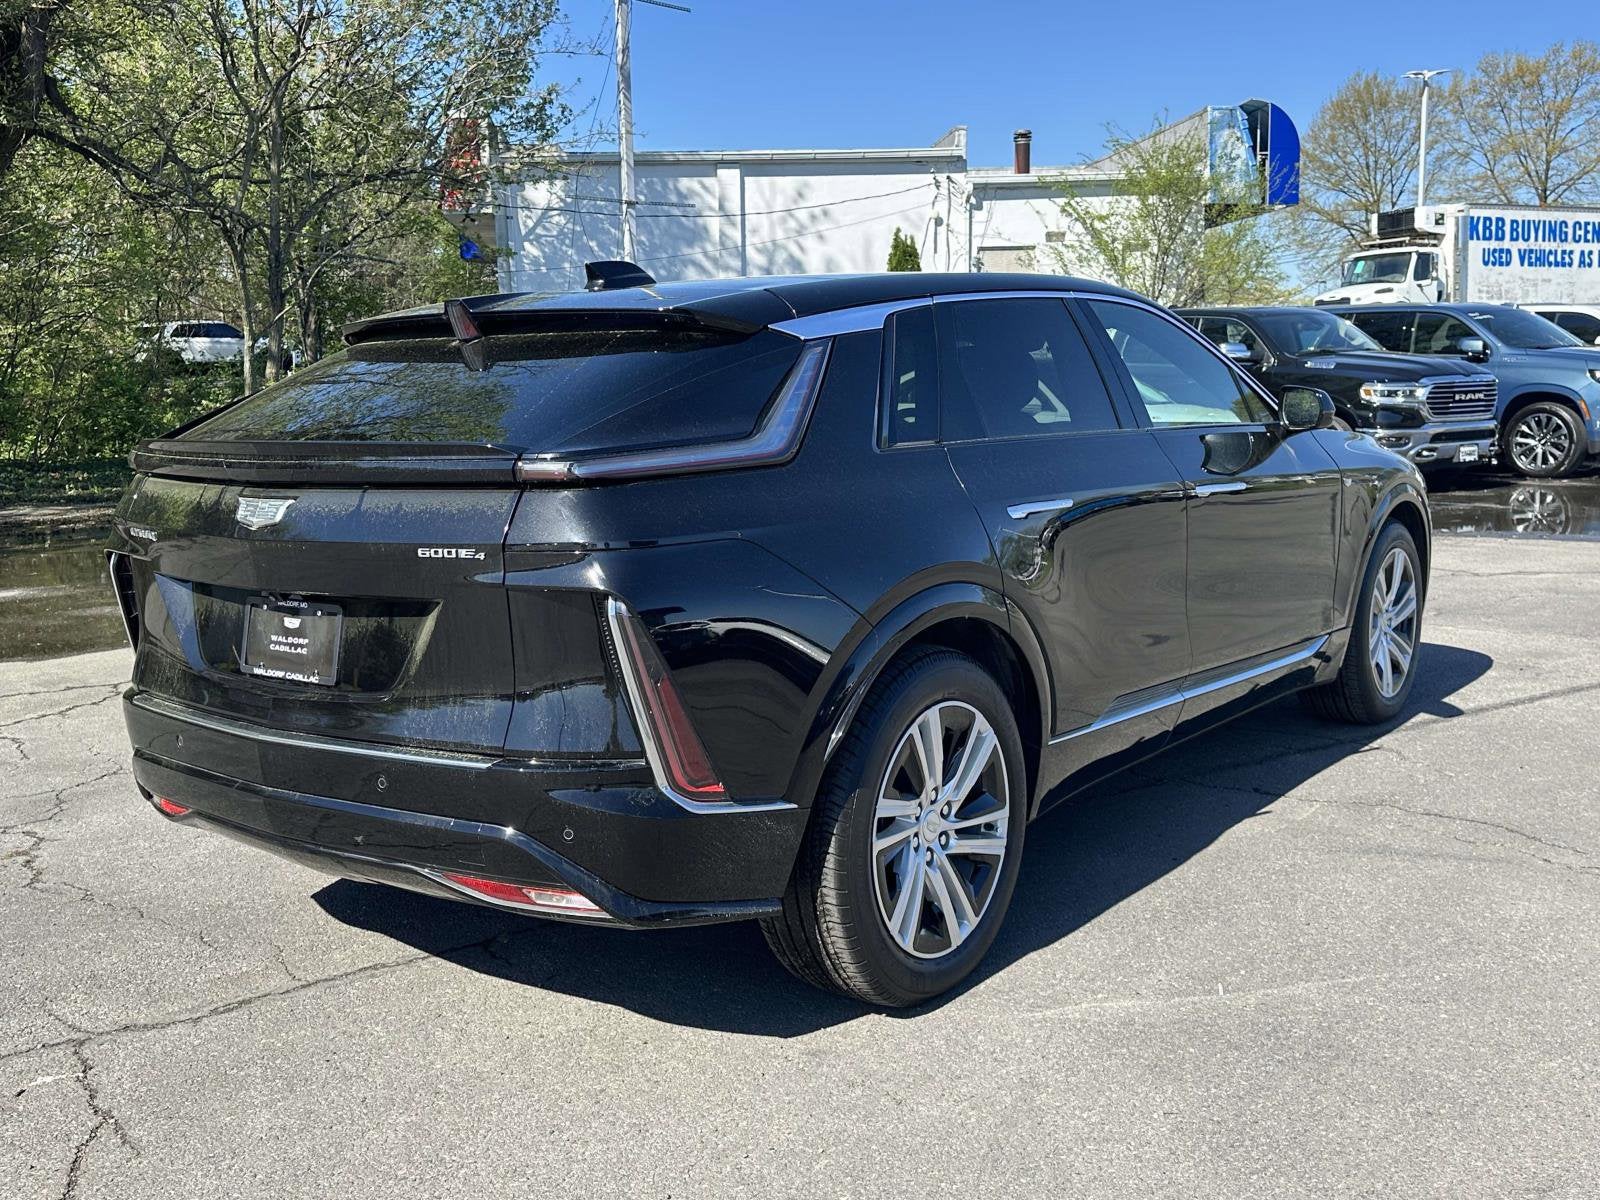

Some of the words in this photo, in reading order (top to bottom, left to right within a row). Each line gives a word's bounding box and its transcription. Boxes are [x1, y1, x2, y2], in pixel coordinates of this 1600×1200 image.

[1469, 216, 1506, 241] KBB
[1509, 219, 1569, 243] BUYING
[1482, 248, 1512, 267] USED
[1517, 248, 1574, 268] VEHICLES
[1578, 250, 1593, 268] AS
[1454, 392, 1486, 401] RAM
[270, 634, 309, 645] WALDORF
[269, 643, 308, 655] CADILLAC
[253, 667, 285, 678] WALDORF
[285, 672, 319, 684] CADILLAC
